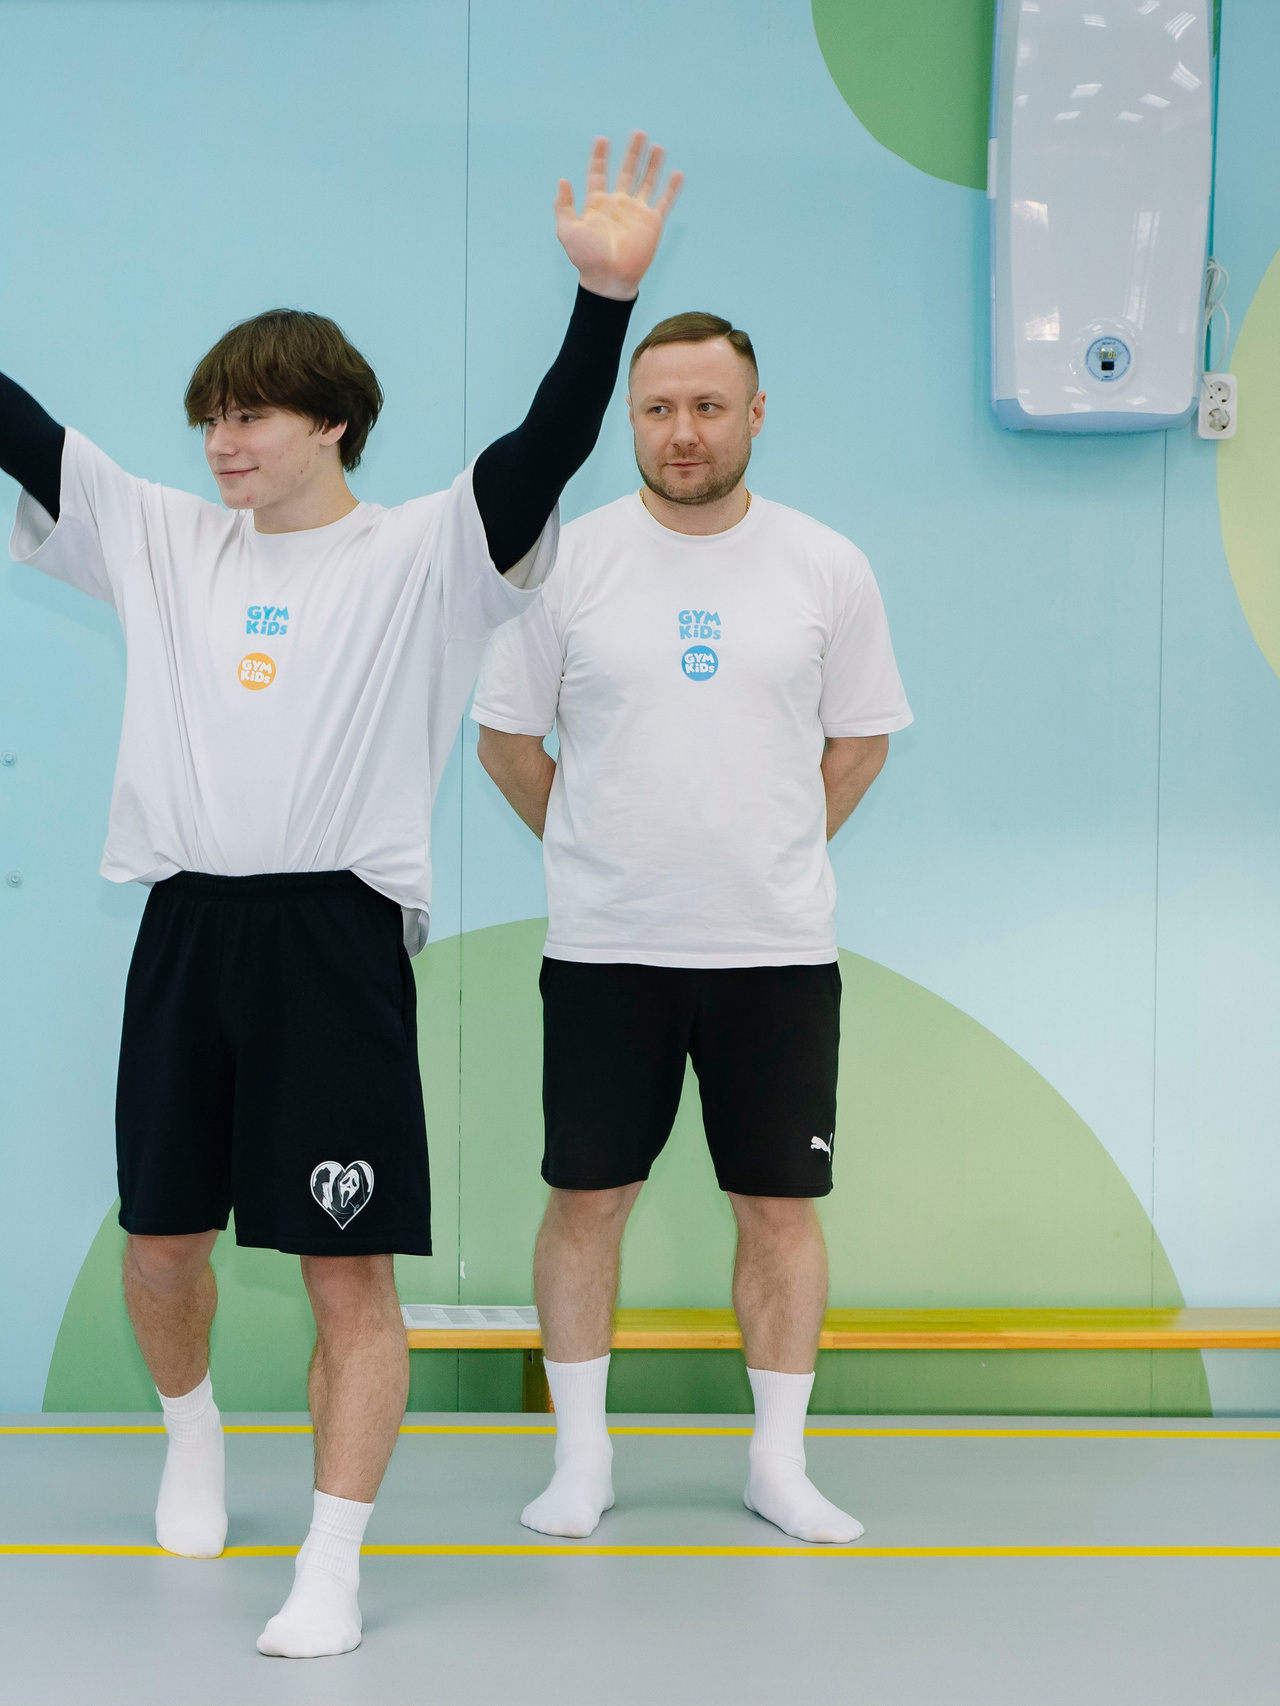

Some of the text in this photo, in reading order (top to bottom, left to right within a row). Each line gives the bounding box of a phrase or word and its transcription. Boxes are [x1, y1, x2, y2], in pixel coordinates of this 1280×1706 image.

[247, 605, 290, 621] GYM
[678, 609, 722, 626] GYM
[684, 652, 715, 664] GYM
[241, 659, 273, 674] GYM
